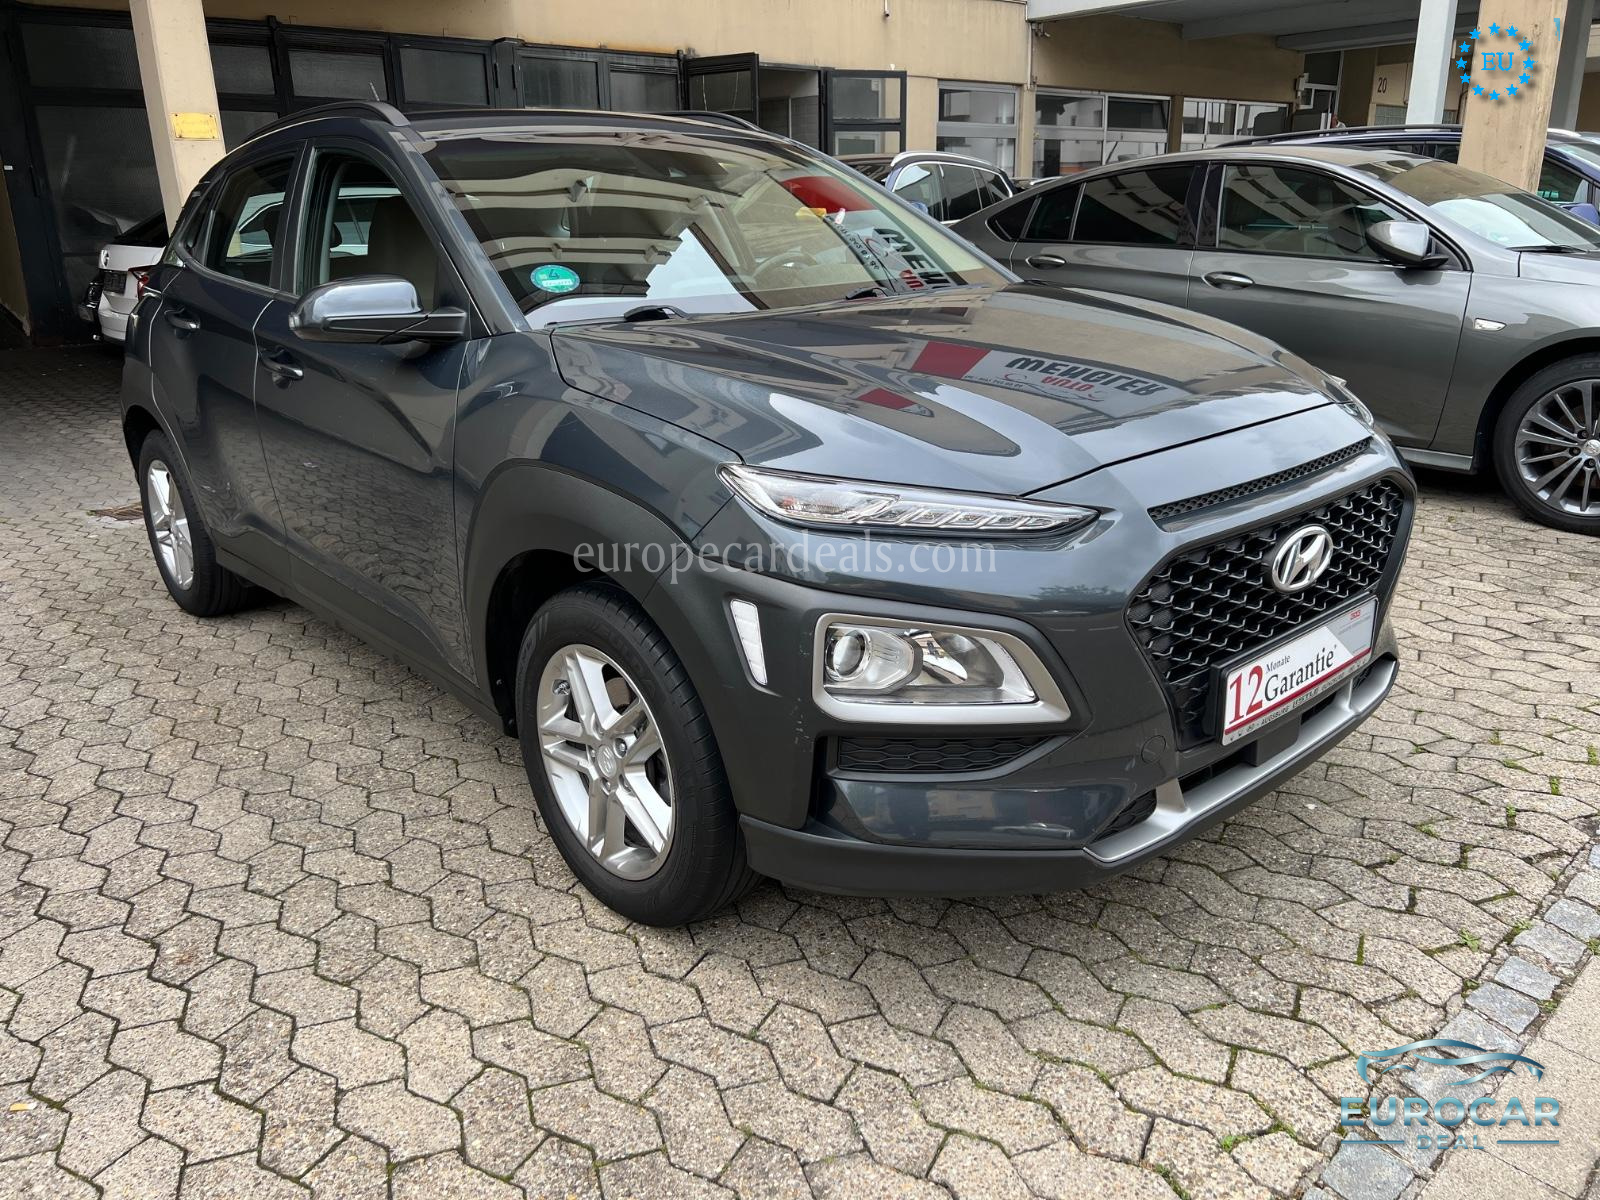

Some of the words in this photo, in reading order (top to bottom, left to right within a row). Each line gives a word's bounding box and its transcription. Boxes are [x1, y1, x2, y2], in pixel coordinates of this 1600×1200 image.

[1377, 77, 1388, 94] 20
[1265, 655, 1291, 674] Monate
[1229, 665, 1263, 725] 12
